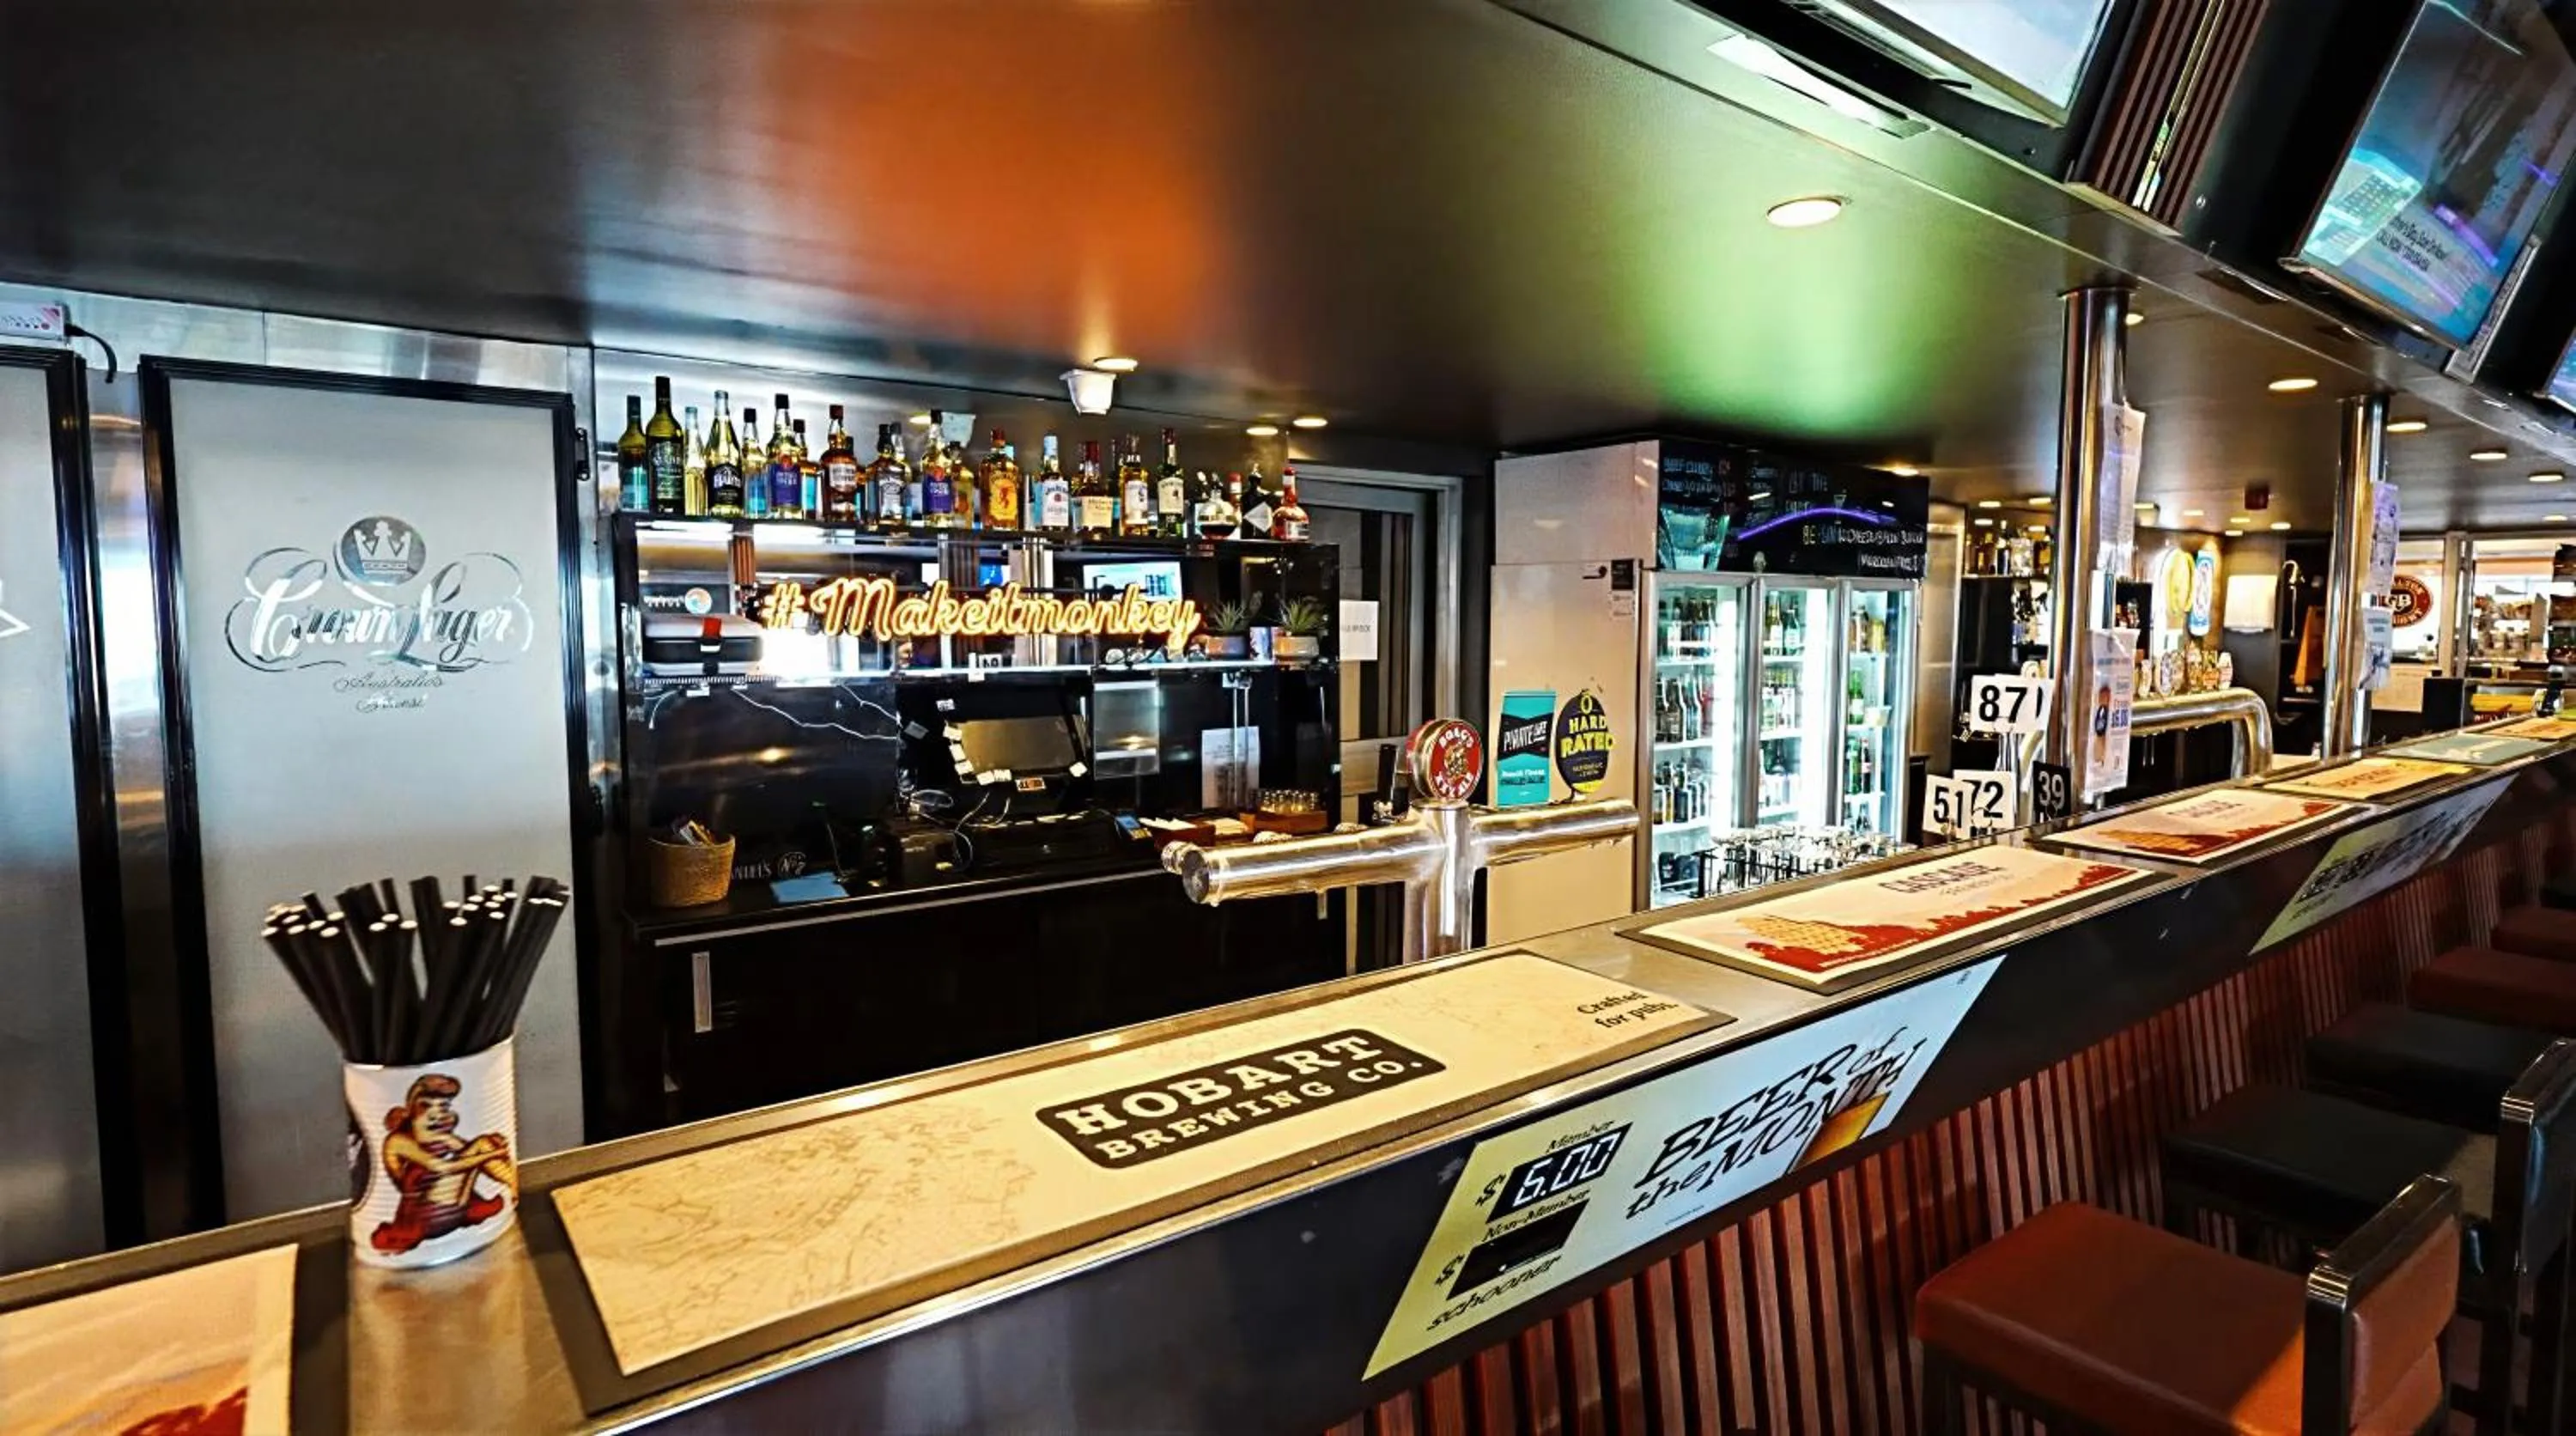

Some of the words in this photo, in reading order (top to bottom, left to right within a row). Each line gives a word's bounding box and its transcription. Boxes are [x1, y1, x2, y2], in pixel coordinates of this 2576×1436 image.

[234, 551, 398, 666] Crown
[761, 576, 1202, 651] #Makeitmonkey
[1569, 715, 1607, 734] HARD
[1978, 685, 2027, 723] 87
[1560, 731, 1614, 758] RATED
[1933, 786, 1964, 829] 51
[2038, 770, 2065, 809] 39
[1577, 990, 1649, 1014] Crafted
[1595, 1013, 1630, 1028] for
[1054, 1035, 1383, 1136] HOBART
[1094, 1080, 1336, 1160] BREWING
[1346, 1058, 1424, 1084] CO.
[1634, 1044, 1858, 1190] BEER
[1846, 1026, 1908, 1076] of
[1546, 1120, 1616, 1153] Member
[1625, 1161, 1707, 1220] the
[1696, 1037, 1929, 1193] MONTH
[1425, 1256, 1562, 1331] schooner
